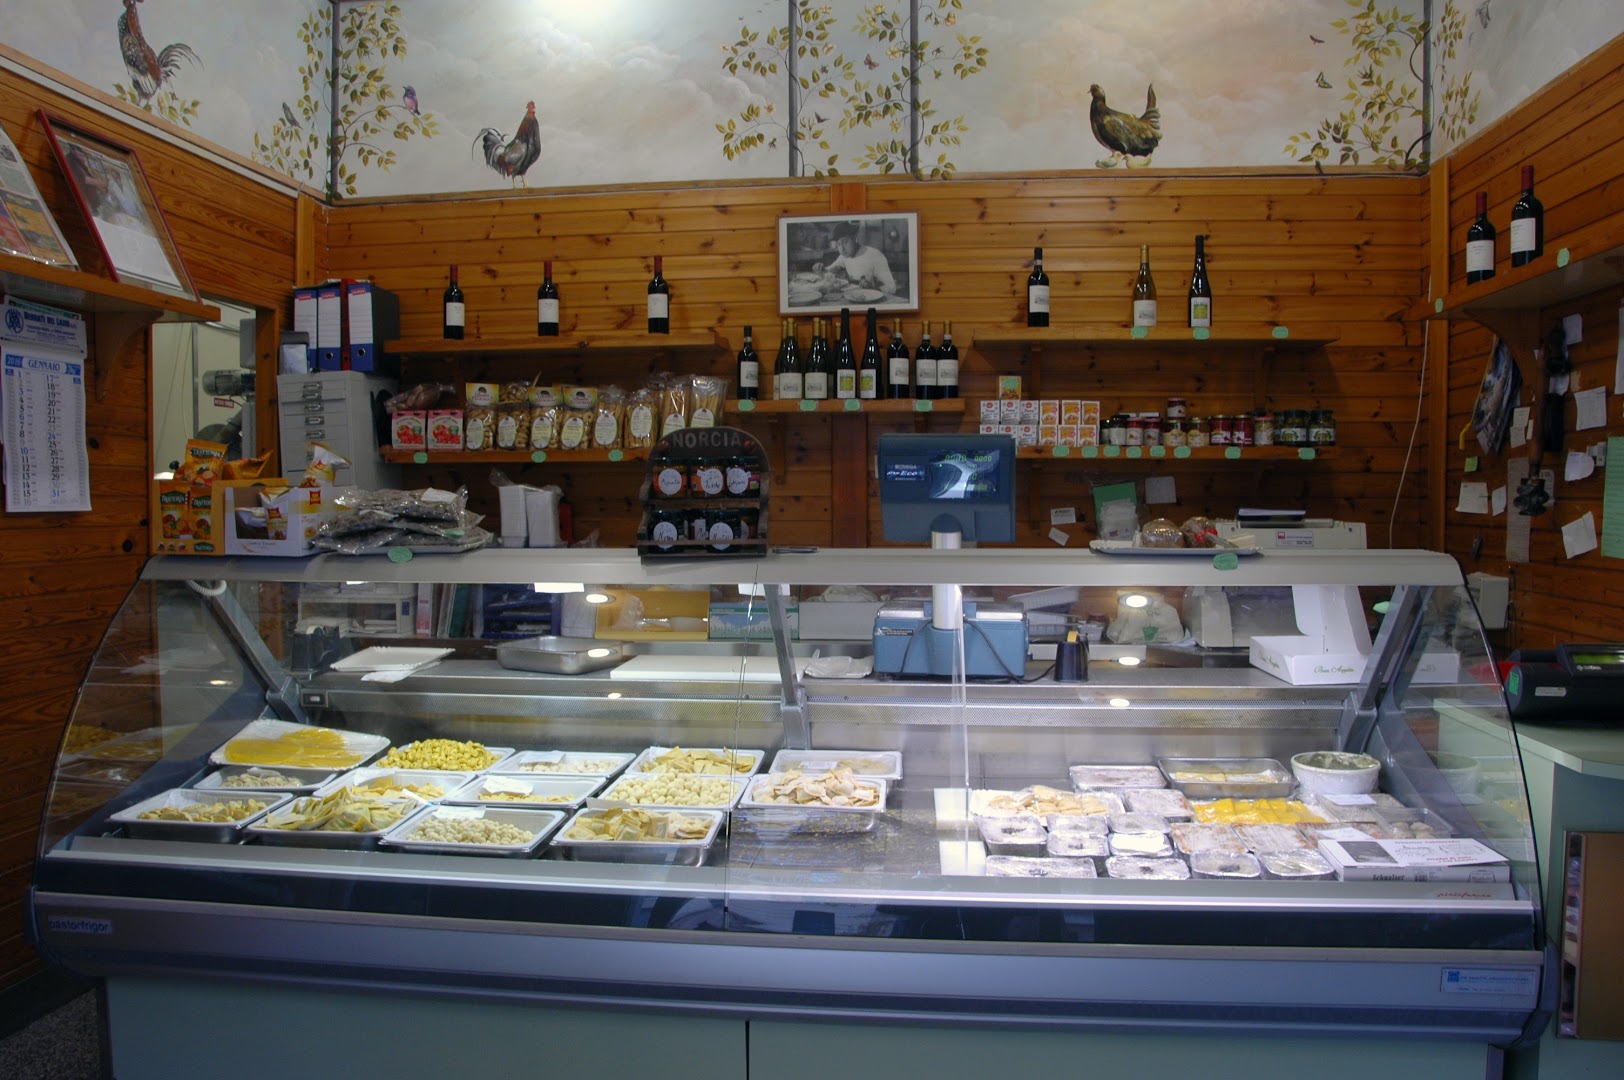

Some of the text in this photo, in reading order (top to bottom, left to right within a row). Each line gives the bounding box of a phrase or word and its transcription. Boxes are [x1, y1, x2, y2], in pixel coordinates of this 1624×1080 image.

[28, 360, 60, 371] GENNAIO
[672, 431, 741, 449] NORCIA
[1437, 891, 1492, 899] pininfarina
